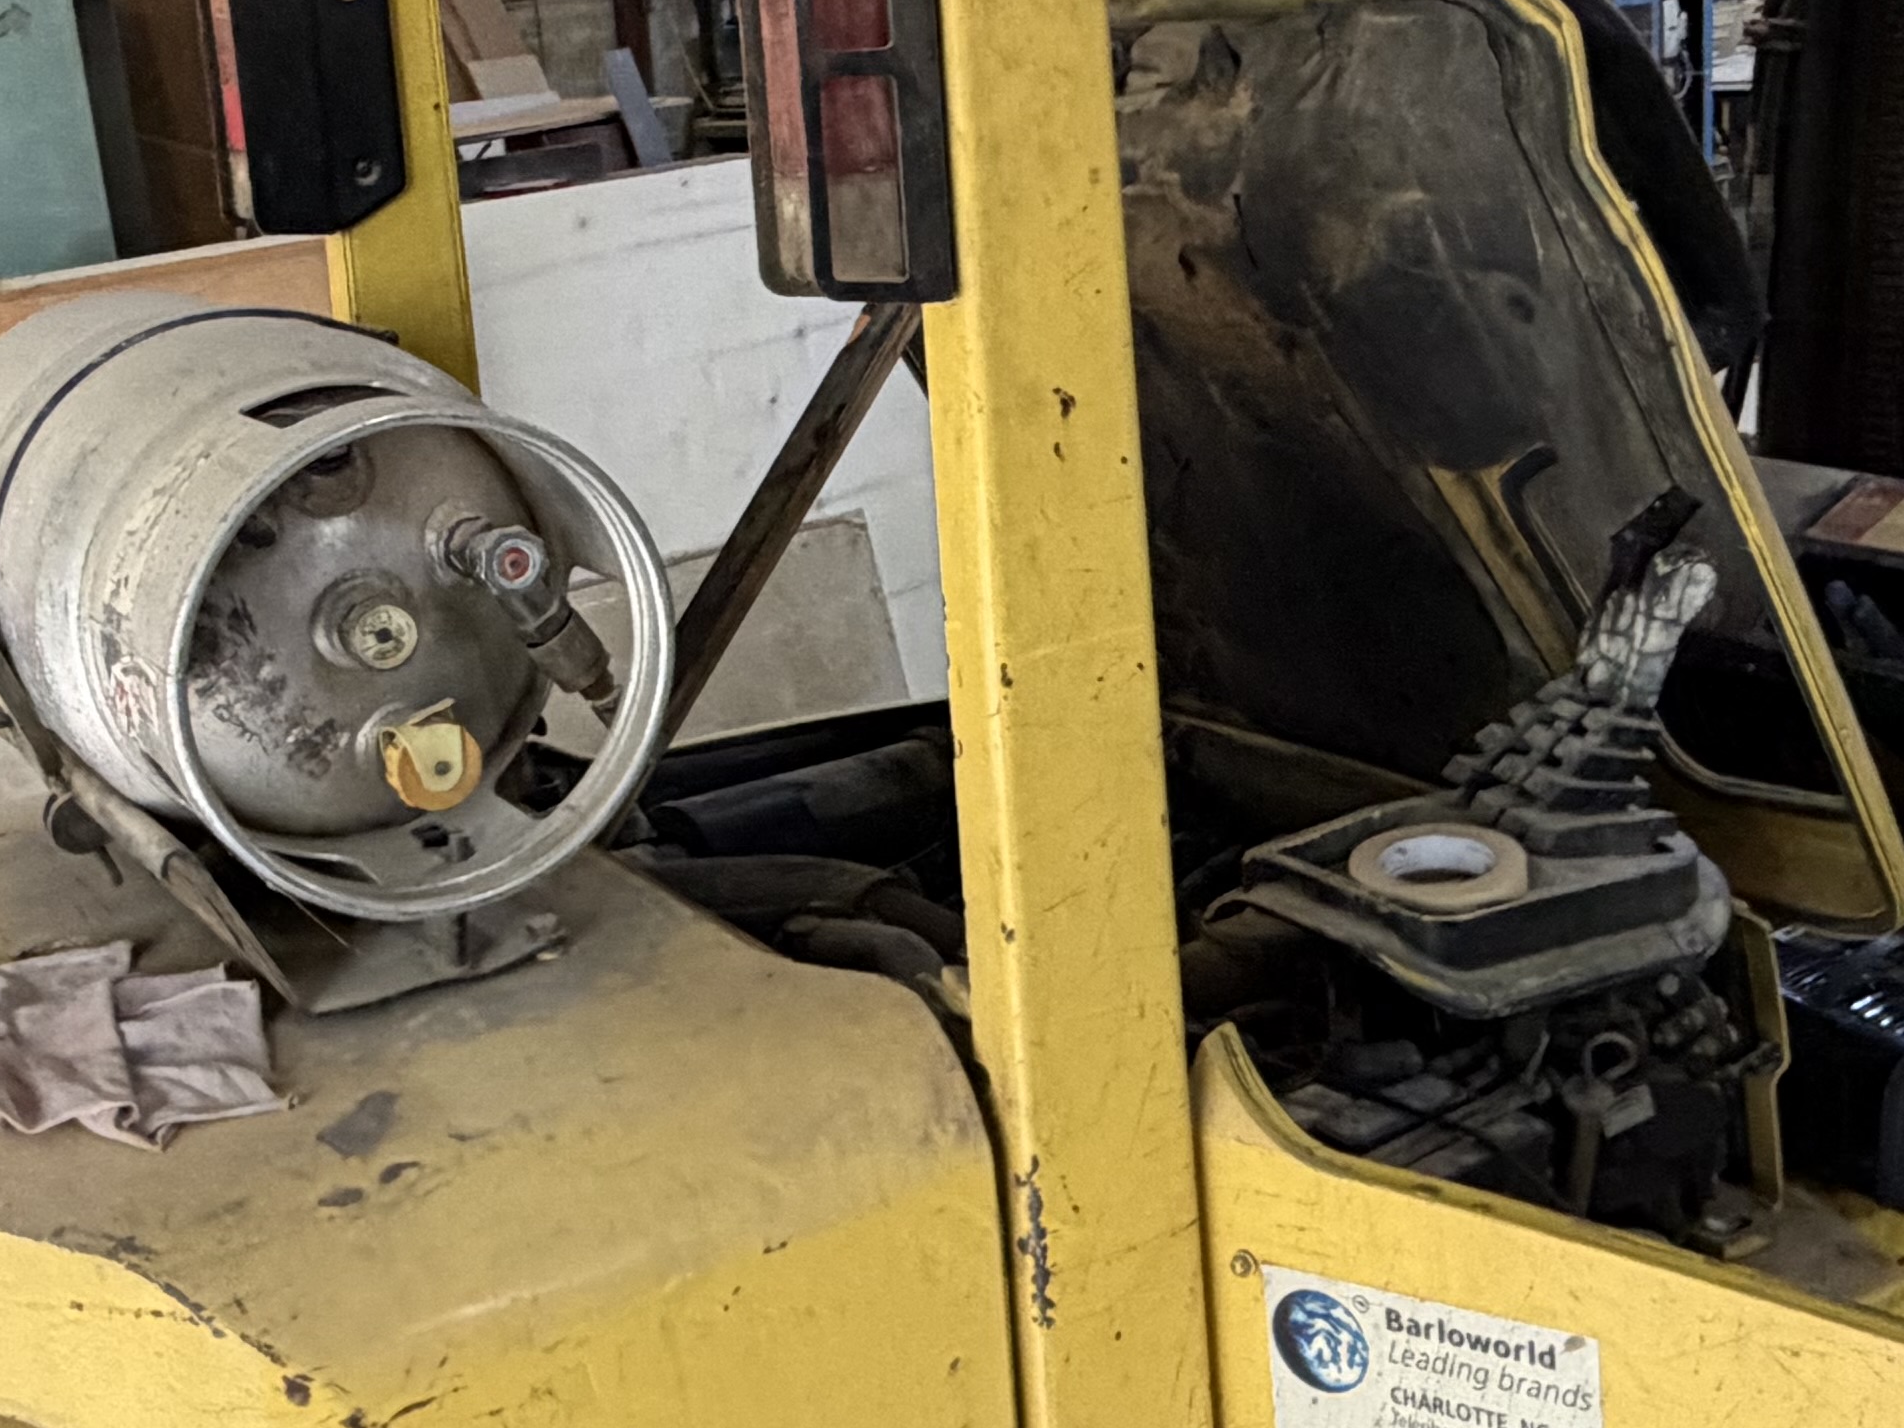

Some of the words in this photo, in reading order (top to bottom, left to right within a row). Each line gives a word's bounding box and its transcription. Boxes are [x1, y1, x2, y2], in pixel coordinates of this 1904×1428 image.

[1385, 1308, 1557, 1370] Barloworld
[1388, 1343, 1490, 1390] Leading
[1498, 1367, 1594, 1412] brands
